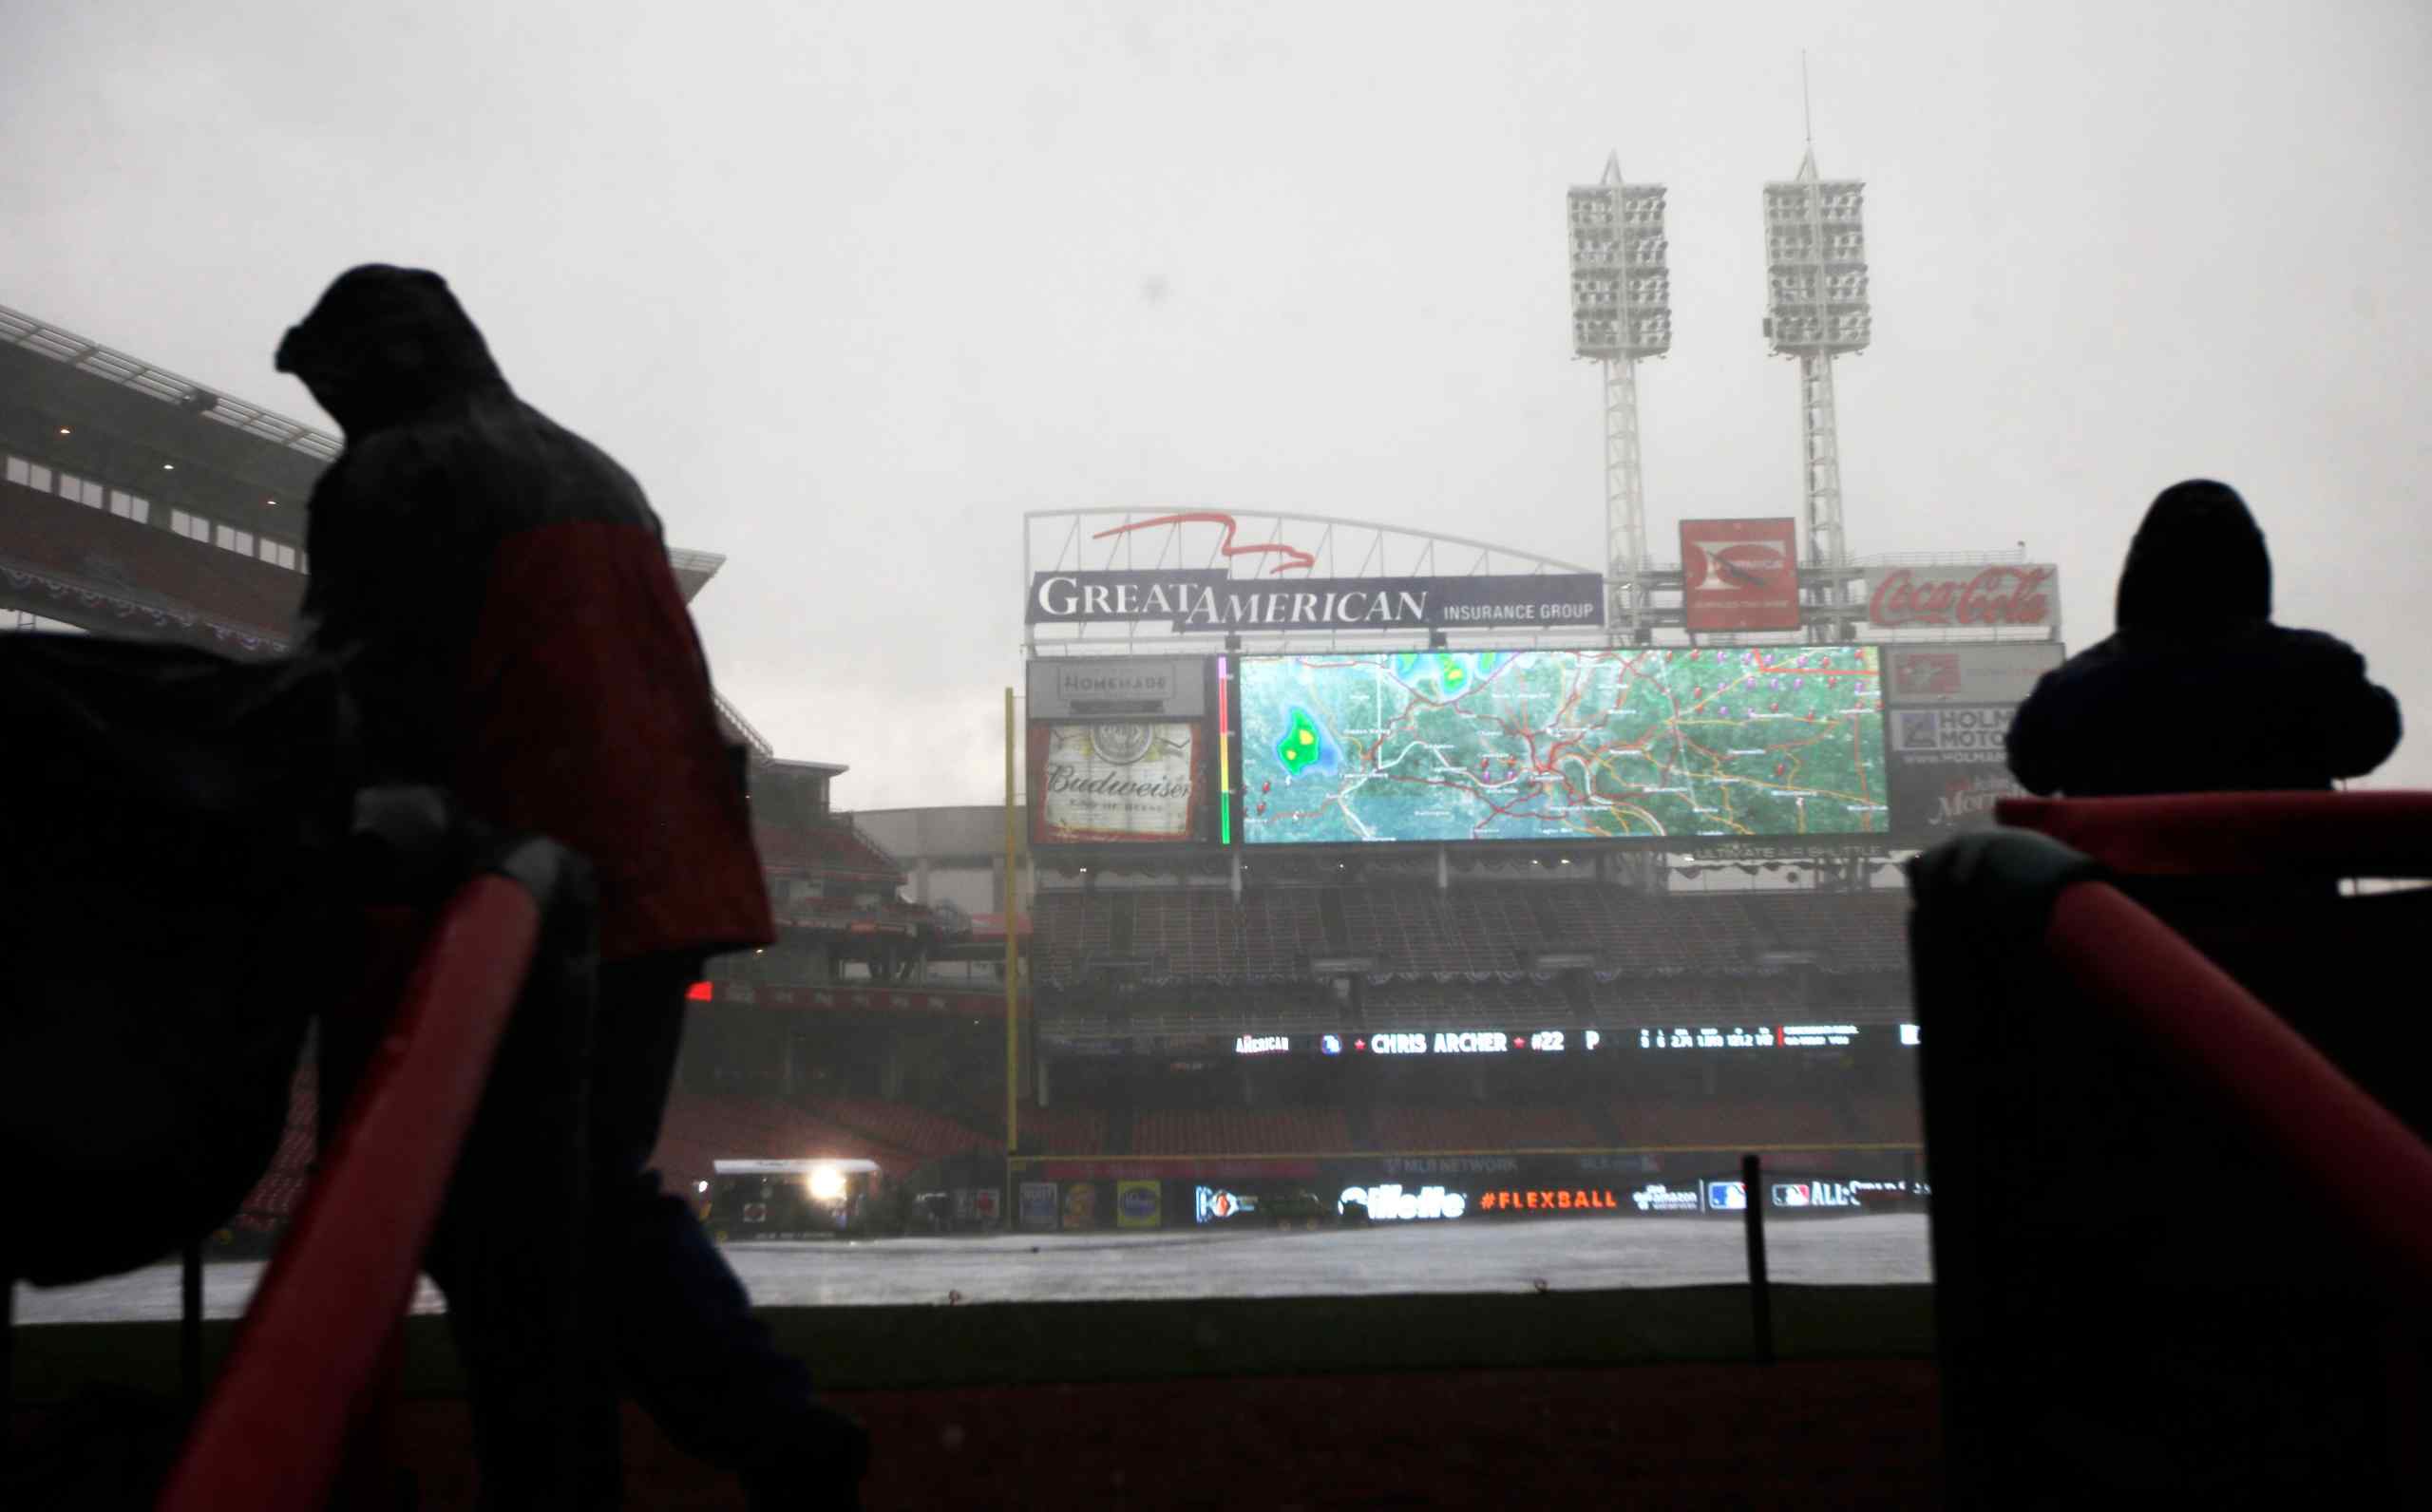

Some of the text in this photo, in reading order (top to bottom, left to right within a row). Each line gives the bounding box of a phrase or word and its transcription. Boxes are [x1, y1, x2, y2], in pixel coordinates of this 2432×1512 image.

[1038, 577, 1594, 626] GREAT AMERICAN INSURANCE GROUP
[1870, 566, 2056, 626] Coca-Cola
[1941, 731, 2004, 747] MOTO
[1047, 763, 1192, 798] Budweiser
[1371, 1030, 1601, 1053] CHRIS ARCHER #22 P
[1481, 1190, 1617, 1210] #FLEXBALL
